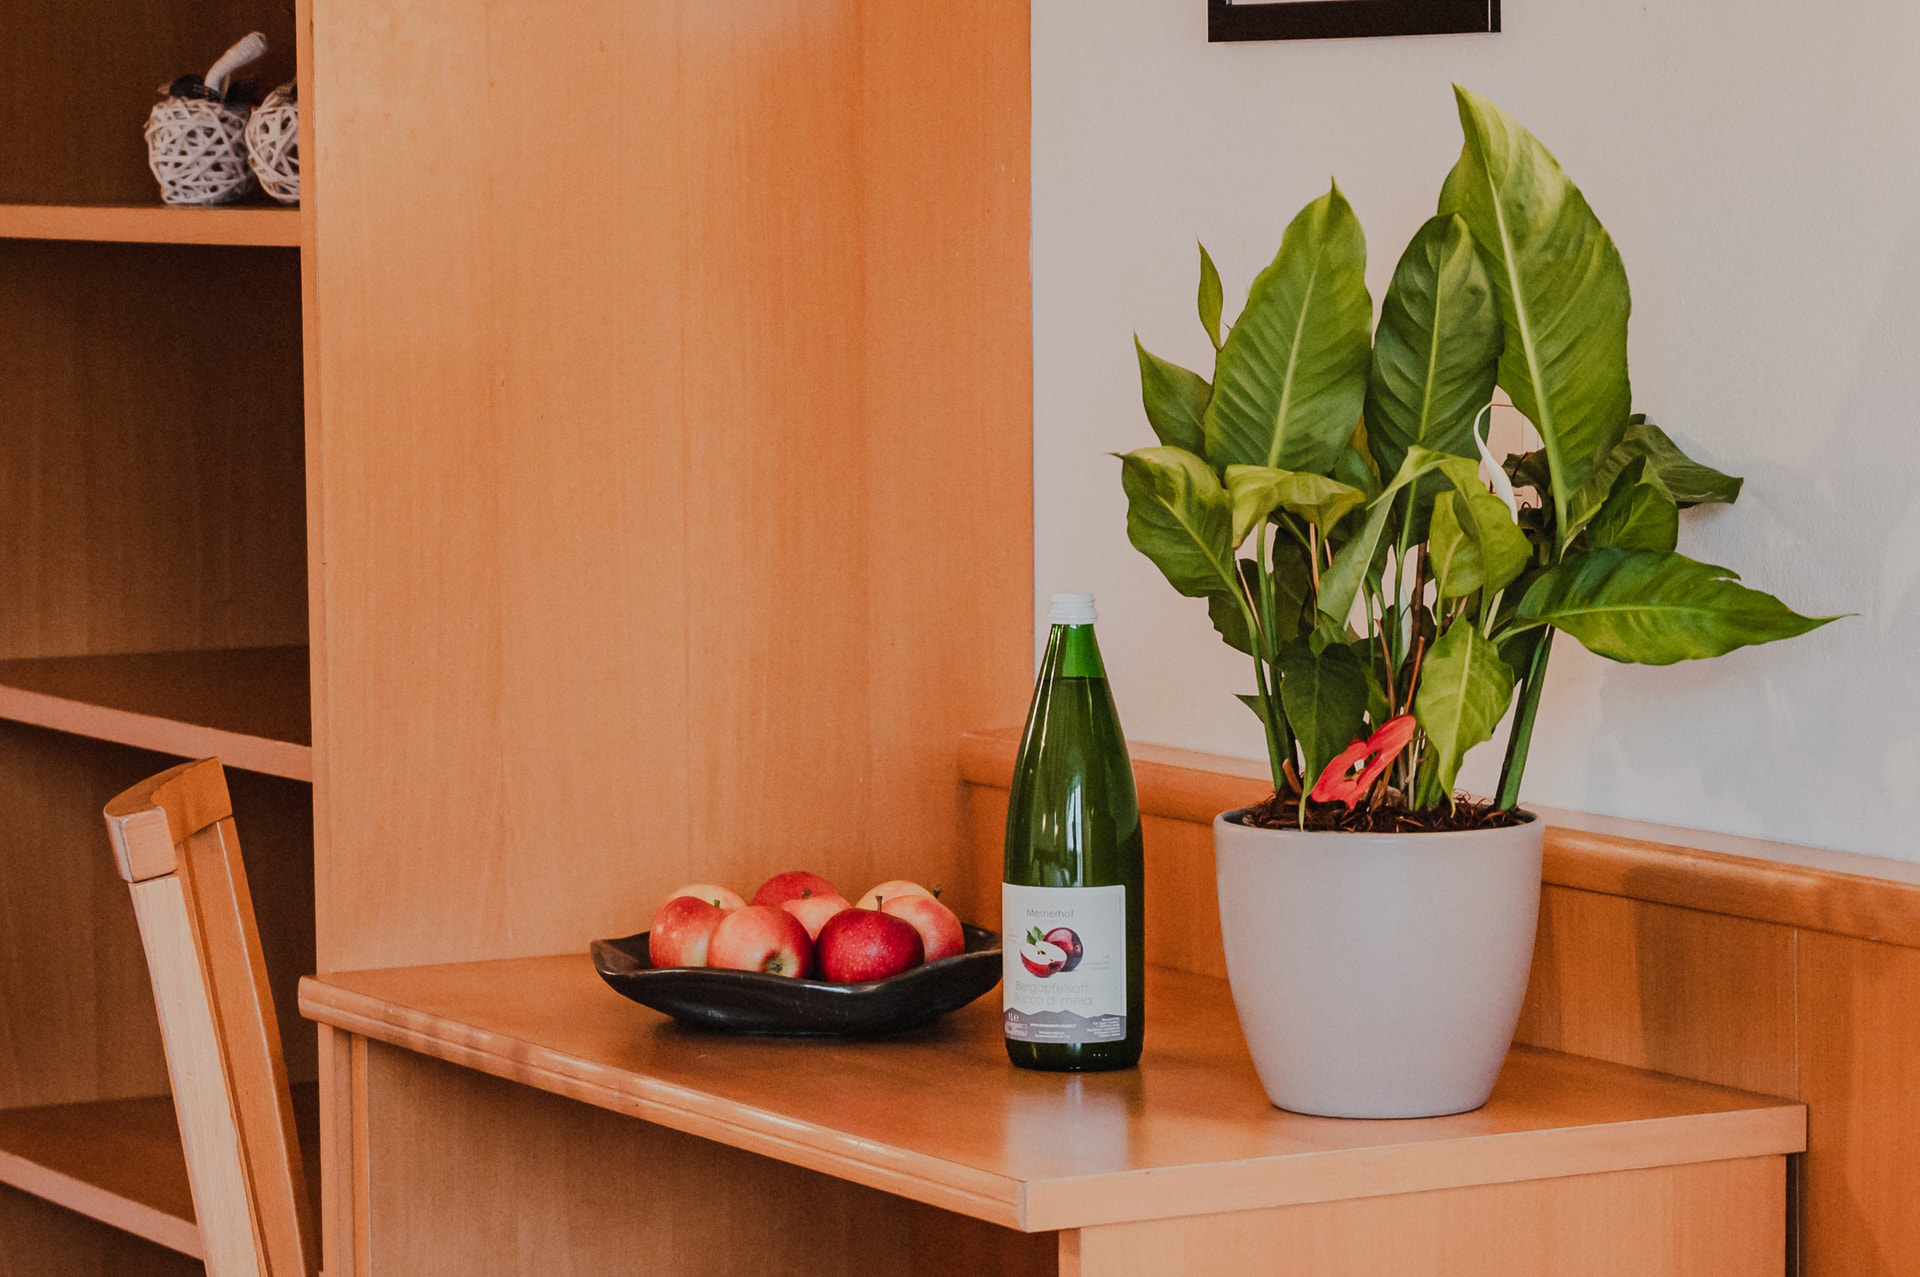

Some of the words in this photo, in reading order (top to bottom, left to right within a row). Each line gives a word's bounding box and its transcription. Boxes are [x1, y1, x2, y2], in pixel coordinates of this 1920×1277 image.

[1026, 908, 1074, 919] Mesnerhof
[1016, 980, 1088, 995] Bergapfelsaft
[1046, 995, 1057, 1005] di
[1060, 995, 1092, 1006] mela
